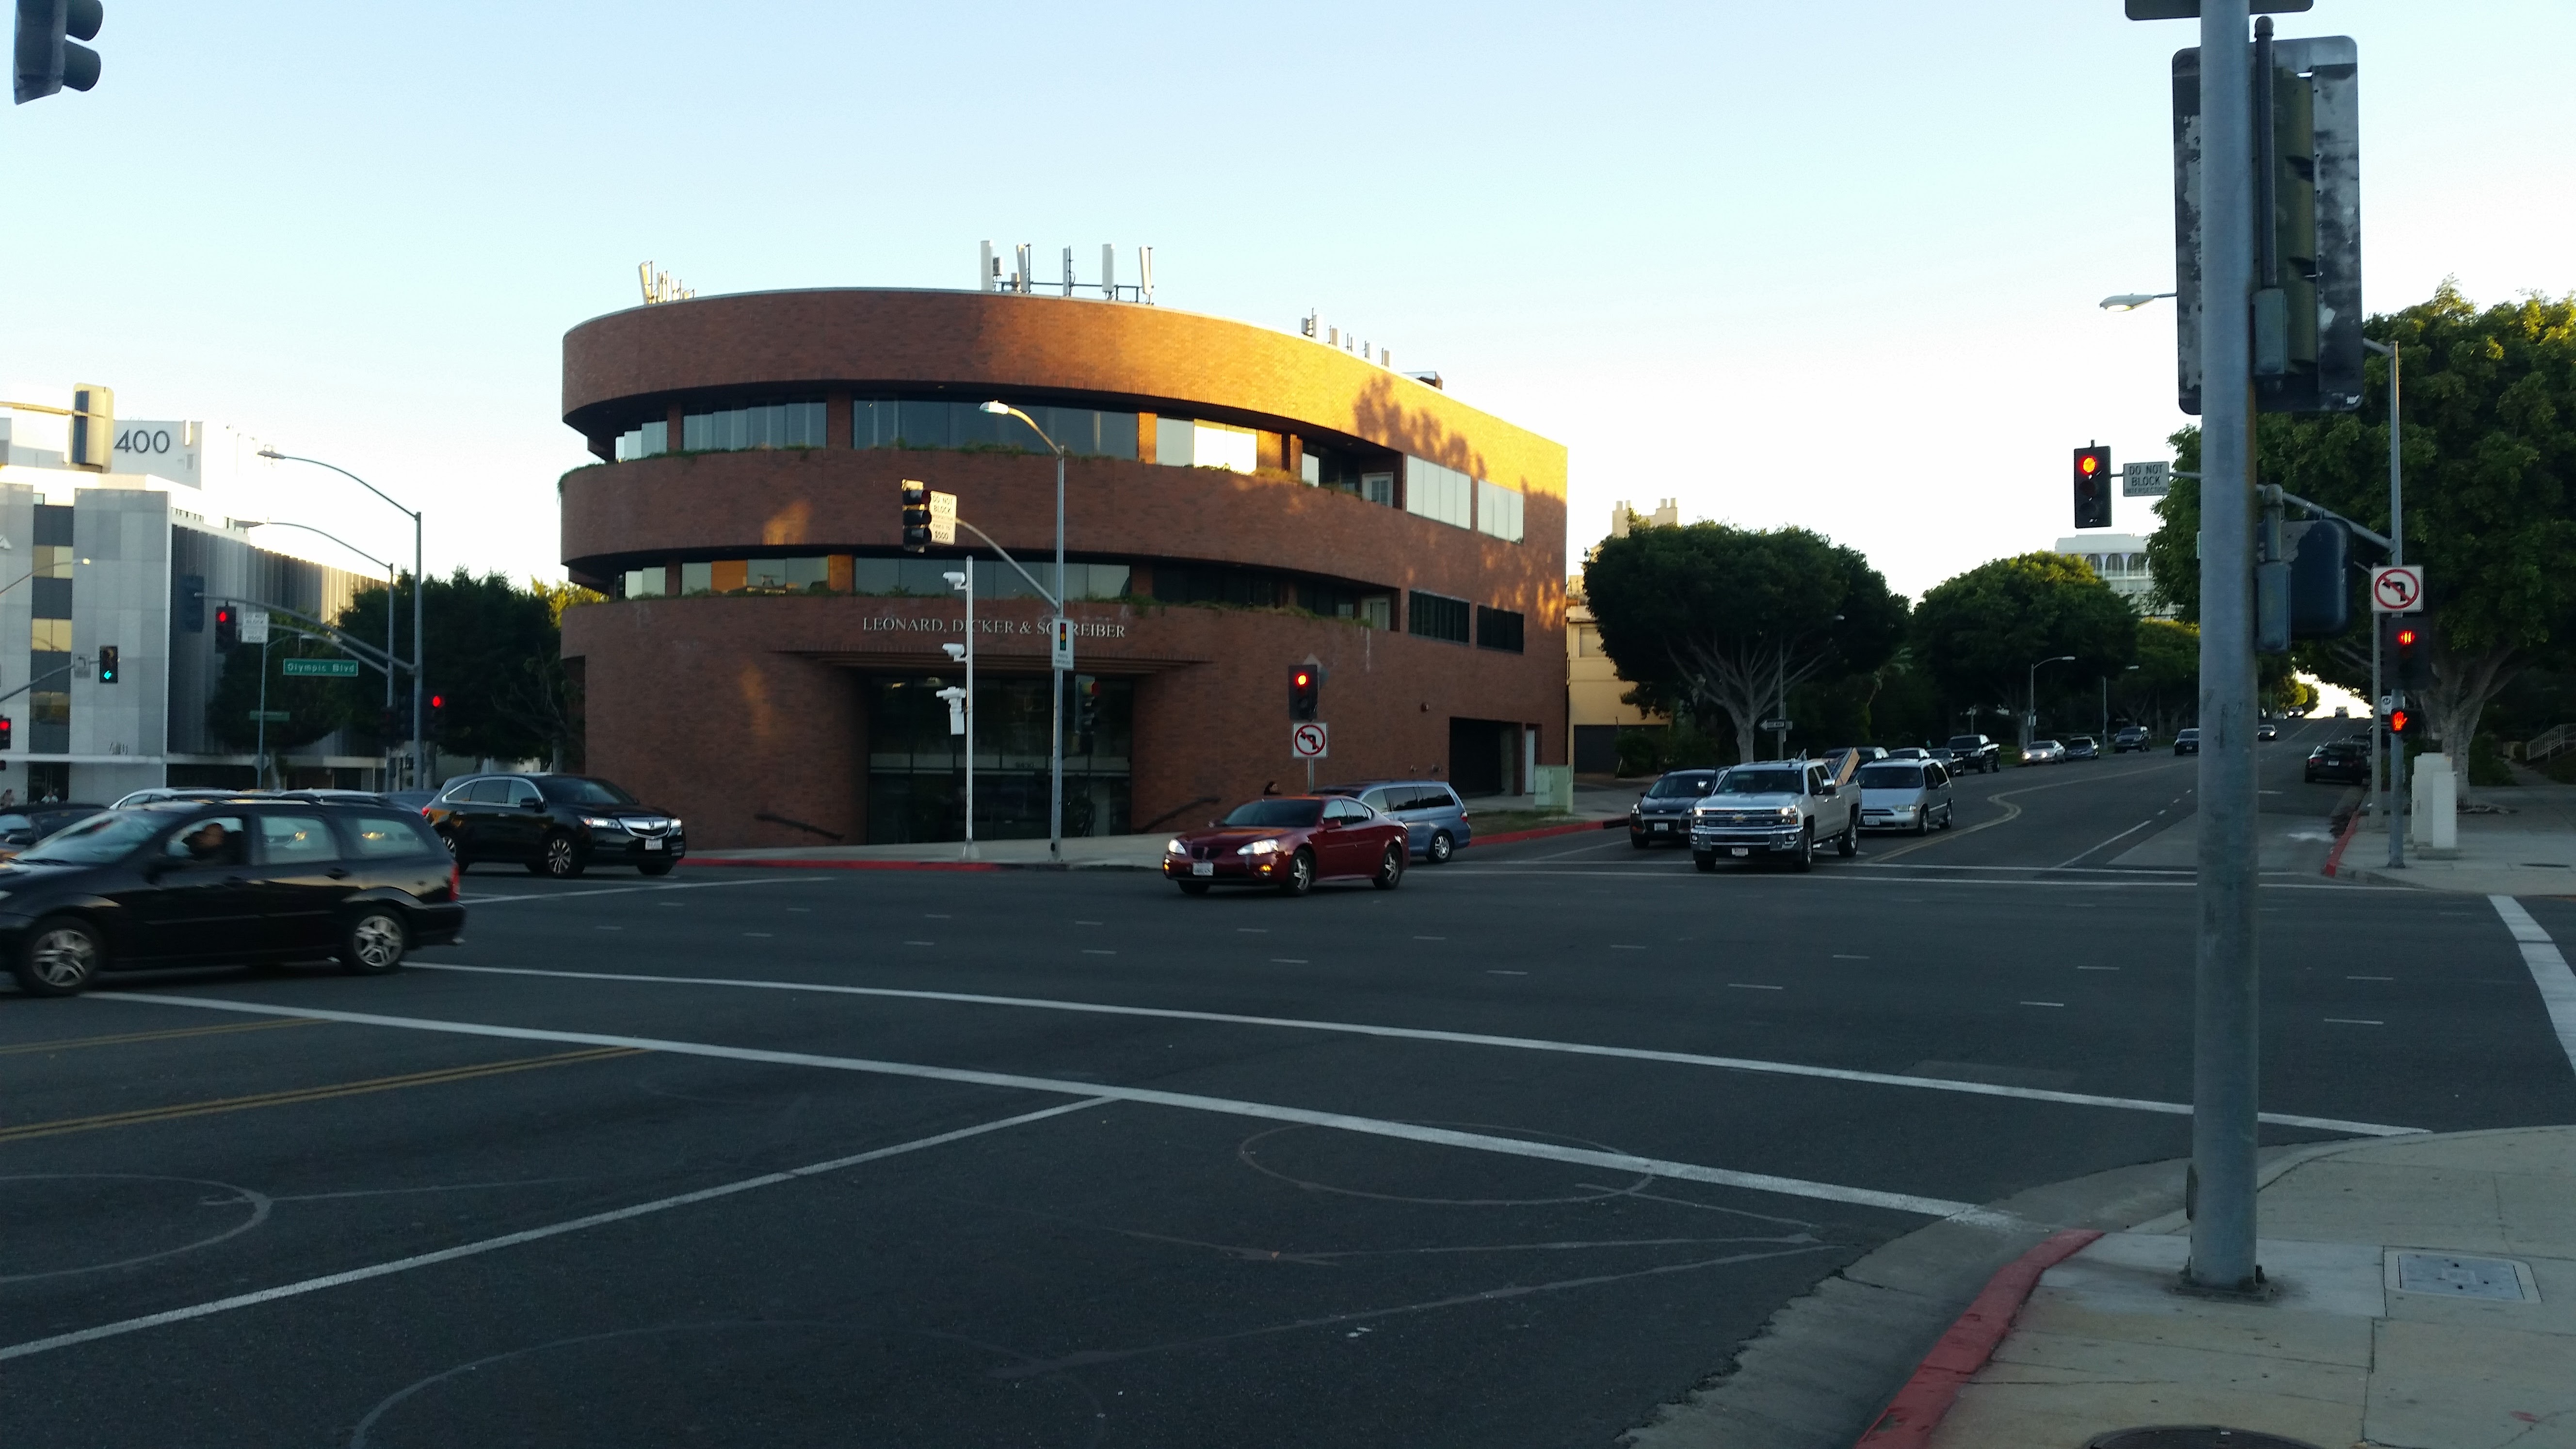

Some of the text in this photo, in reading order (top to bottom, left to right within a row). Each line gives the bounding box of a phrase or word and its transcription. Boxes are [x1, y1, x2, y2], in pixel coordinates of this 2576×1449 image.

[114, 430, 170, 453] 400
[2129, 464, 2163, 475] DO NOT
[2132, 476, 2160, 486] BLOCK
[933, 495, 940, 503] DO
[934, 505, 951, 515] BLOCK
[934, 531, 949, 540] $500
[863, 617, 1126, 639] LEONARD, DCKER & SCREIBER
[288, 663, 354, 673] Olympic Blvd
